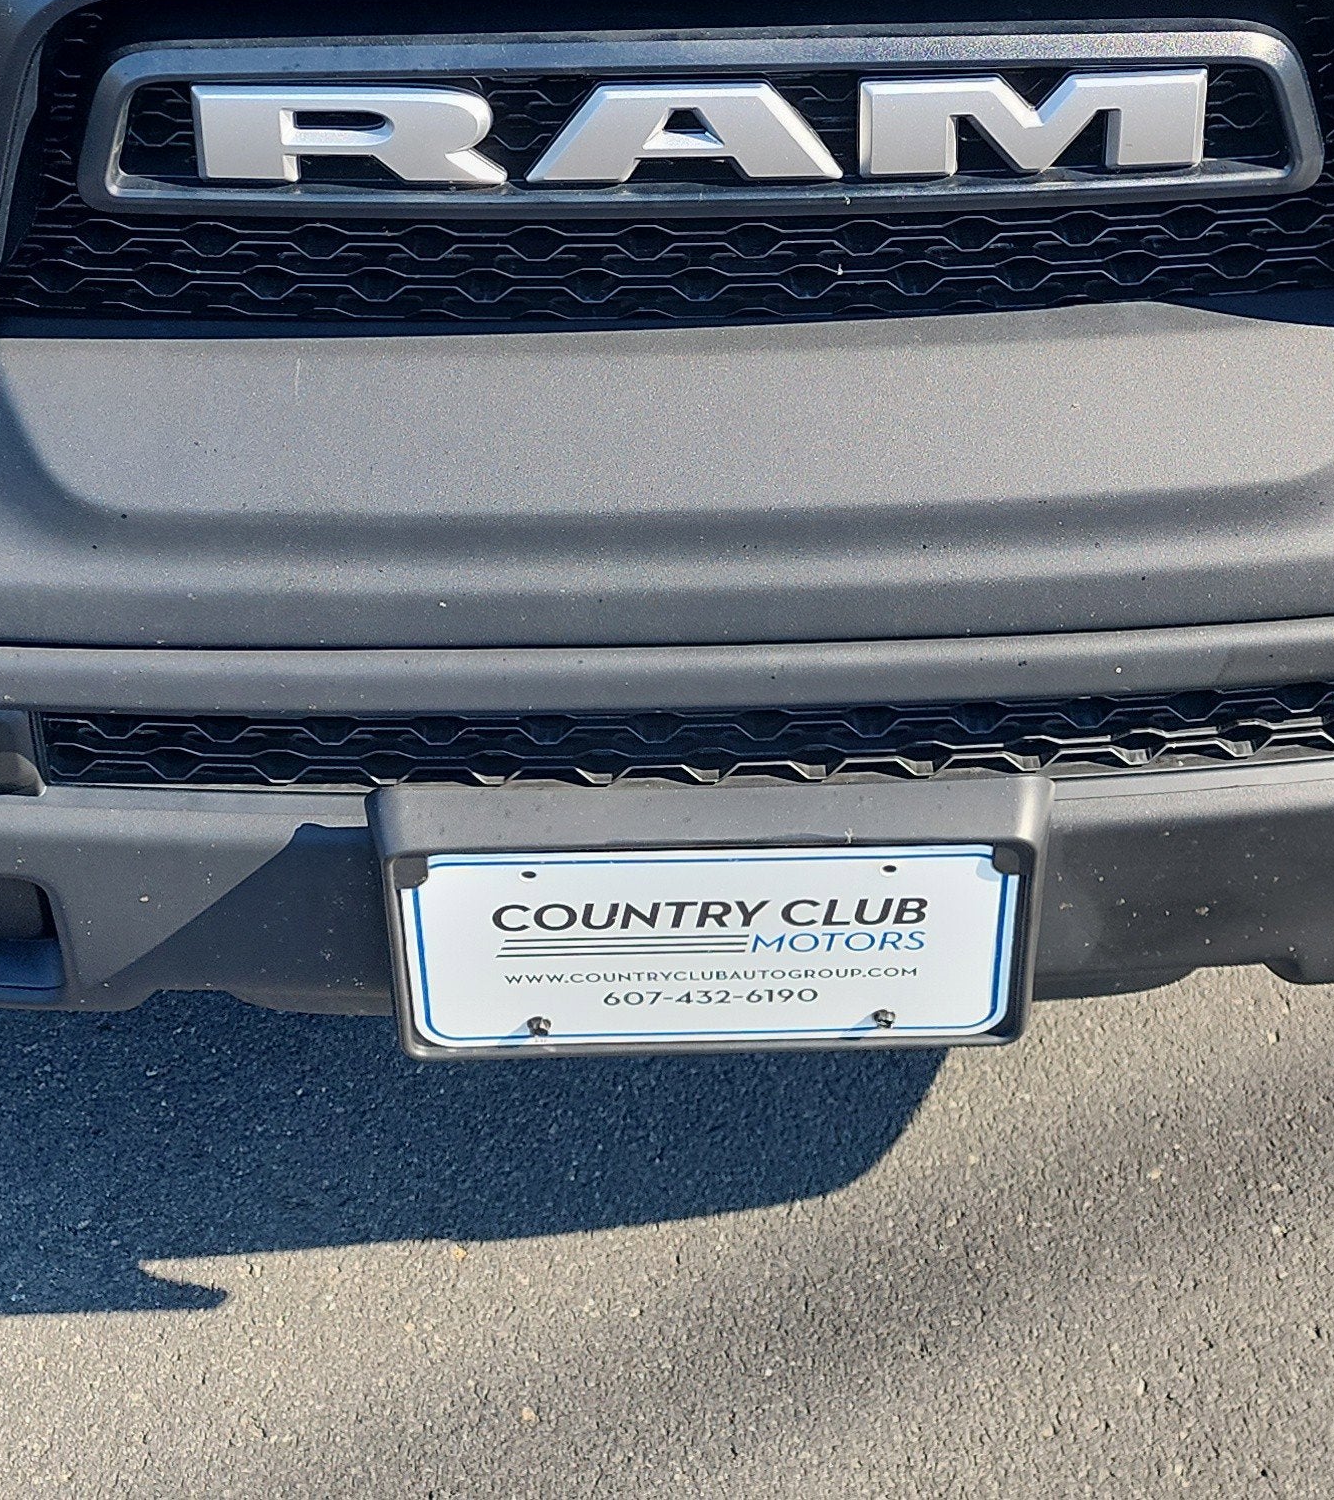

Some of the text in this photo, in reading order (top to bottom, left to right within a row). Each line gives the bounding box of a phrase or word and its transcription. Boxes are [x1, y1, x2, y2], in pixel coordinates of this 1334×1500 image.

[189, 68, 1209, 186] RAM
[491, 897, 929, 932] COUNTRY CLUB
[750, 931, 926, 954] MOTORS
[504, 967, 918, 986] WWW.COUNTRYCLUBAUTOGROUP.COM
[602, 988, 819, 1008] 607-432-6190
